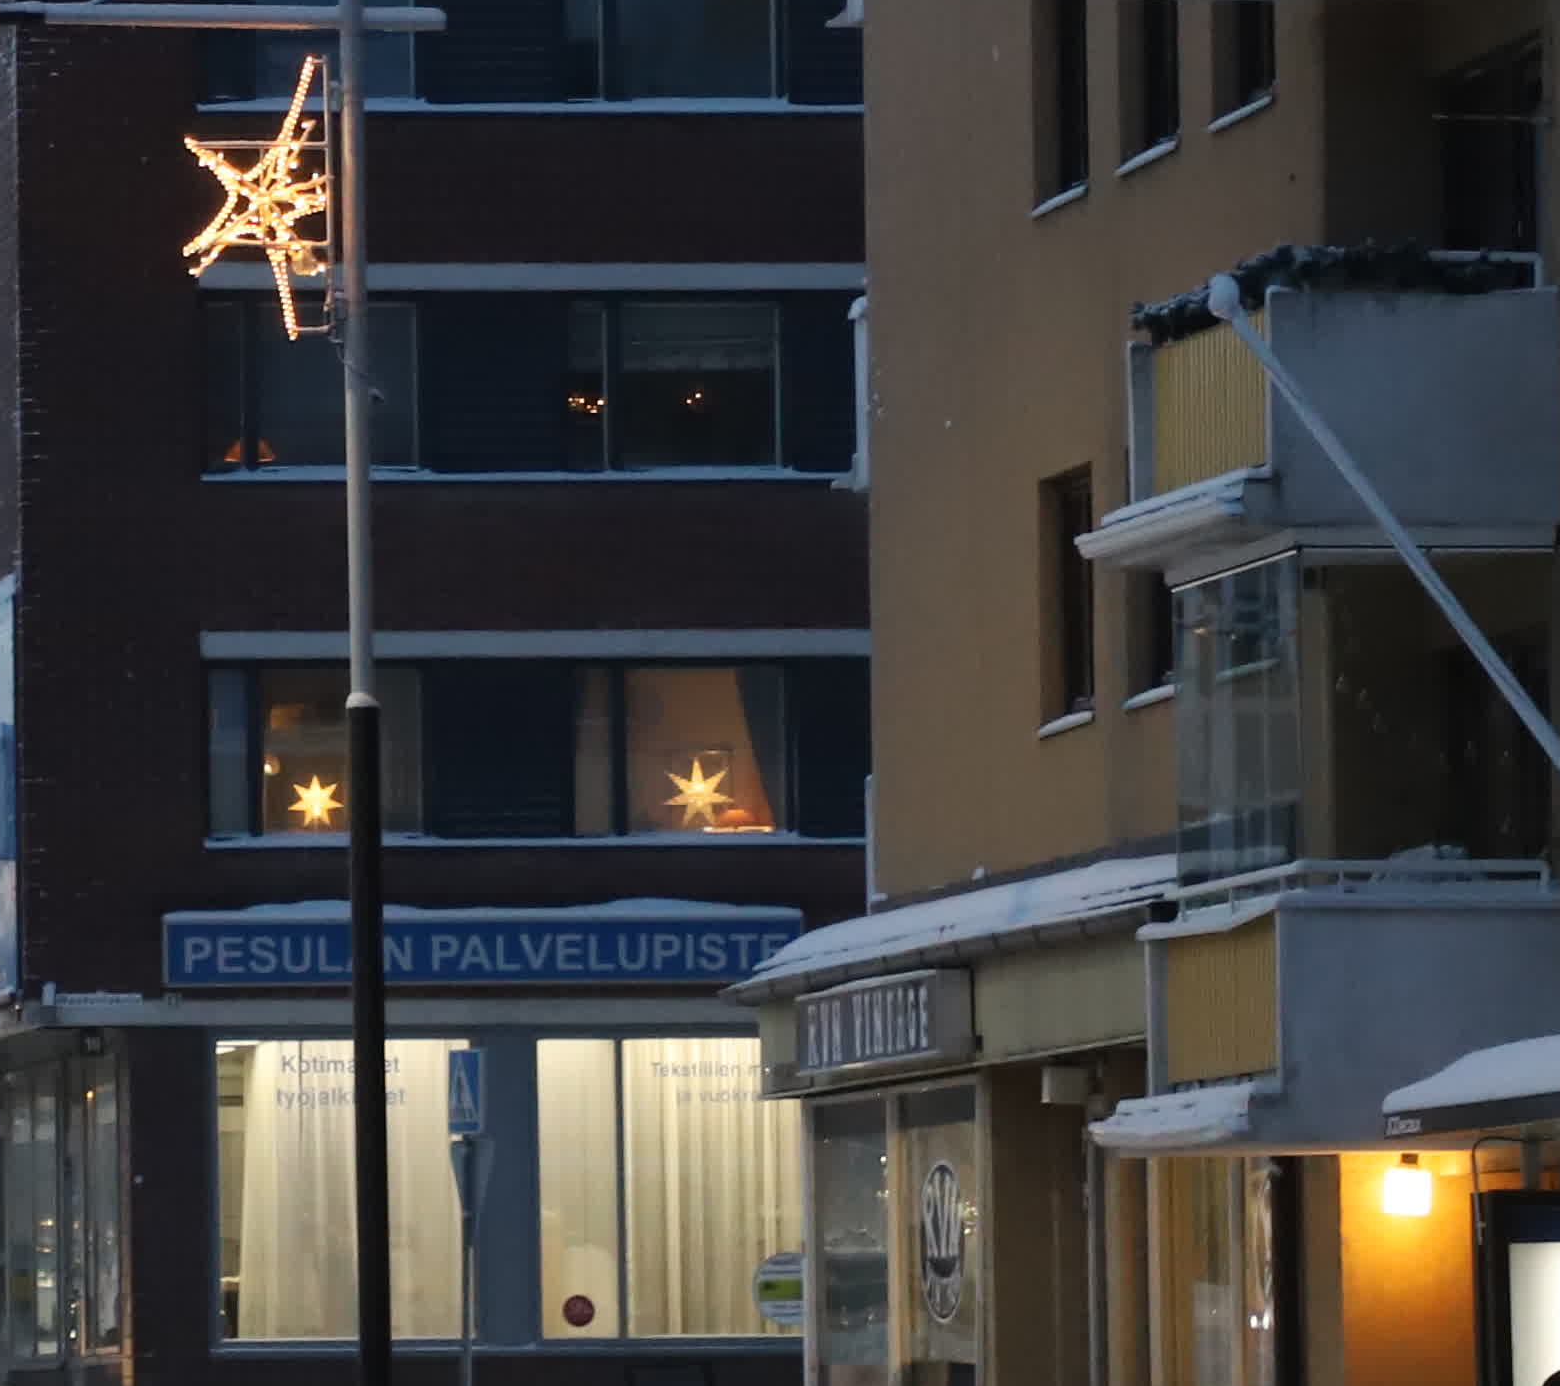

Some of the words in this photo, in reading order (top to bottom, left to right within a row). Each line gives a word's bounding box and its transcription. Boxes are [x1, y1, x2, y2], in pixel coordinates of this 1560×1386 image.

[183, 934, 414, 974] PESULN
[852, 984, 930, 1059] VINTAGE
[281, 1054, 400, 1074] Kotimaet
